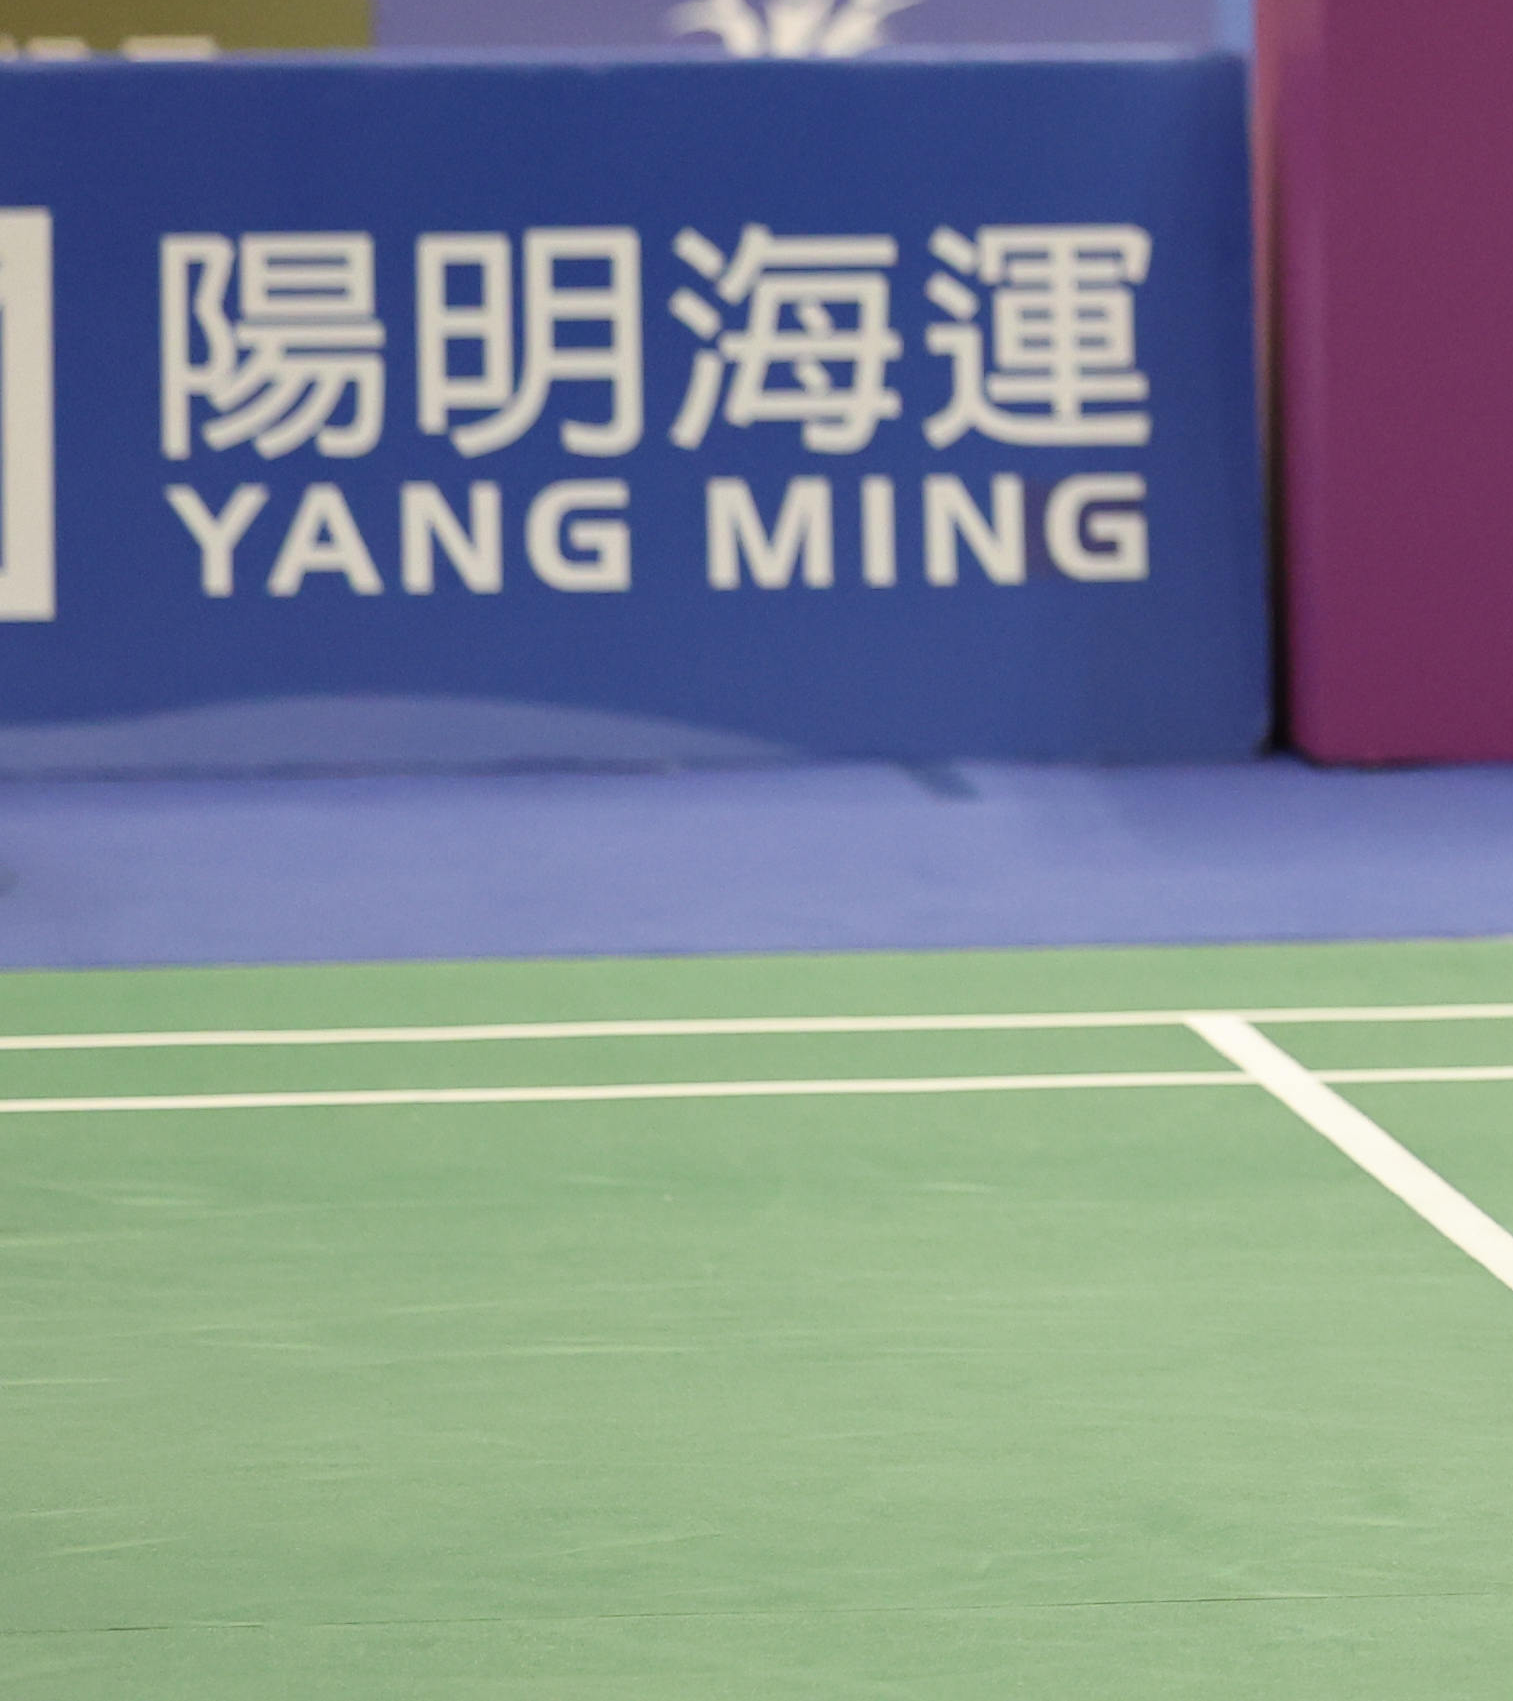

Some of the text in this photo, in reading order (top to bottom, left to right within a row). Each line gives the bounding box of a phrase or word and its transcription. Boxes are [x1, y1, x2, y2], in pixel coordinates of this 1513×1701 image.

[161, 223, 1151, 460] 陽明海運
[167, 473, 1148, 597] YANG MING
